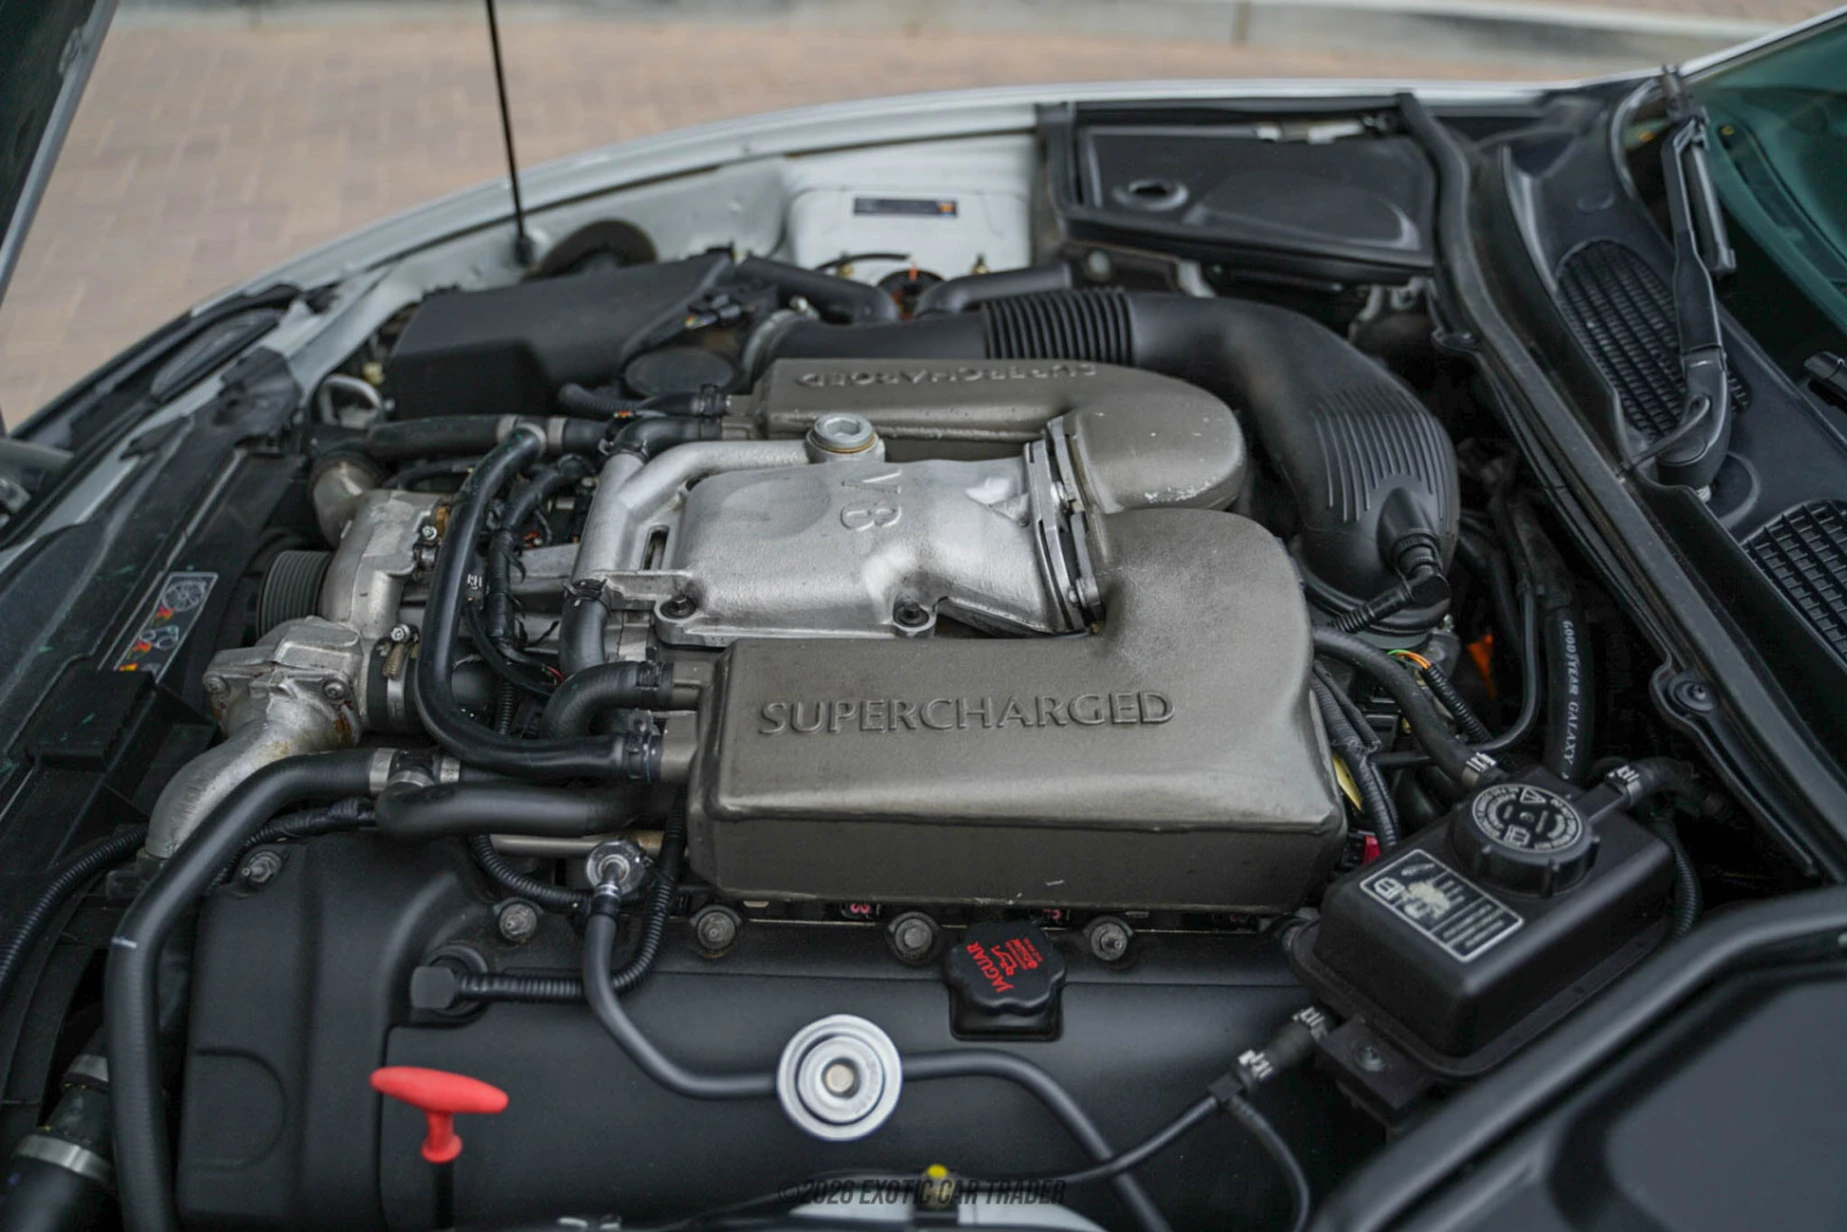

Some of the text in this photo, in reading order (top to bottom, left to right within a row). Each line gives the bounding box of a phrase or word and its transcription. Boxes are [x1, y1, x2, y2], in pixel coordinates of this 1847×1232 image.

[839, 468, 903, 532] V8
[1562, 620, 1581, 696] GOODYEAR
[758, 690, 1177, 736] SUPERCHARGED
[1563, 701, 1580, 766] GALAXY
[966, 940, 1015, 994] JAGUAR
